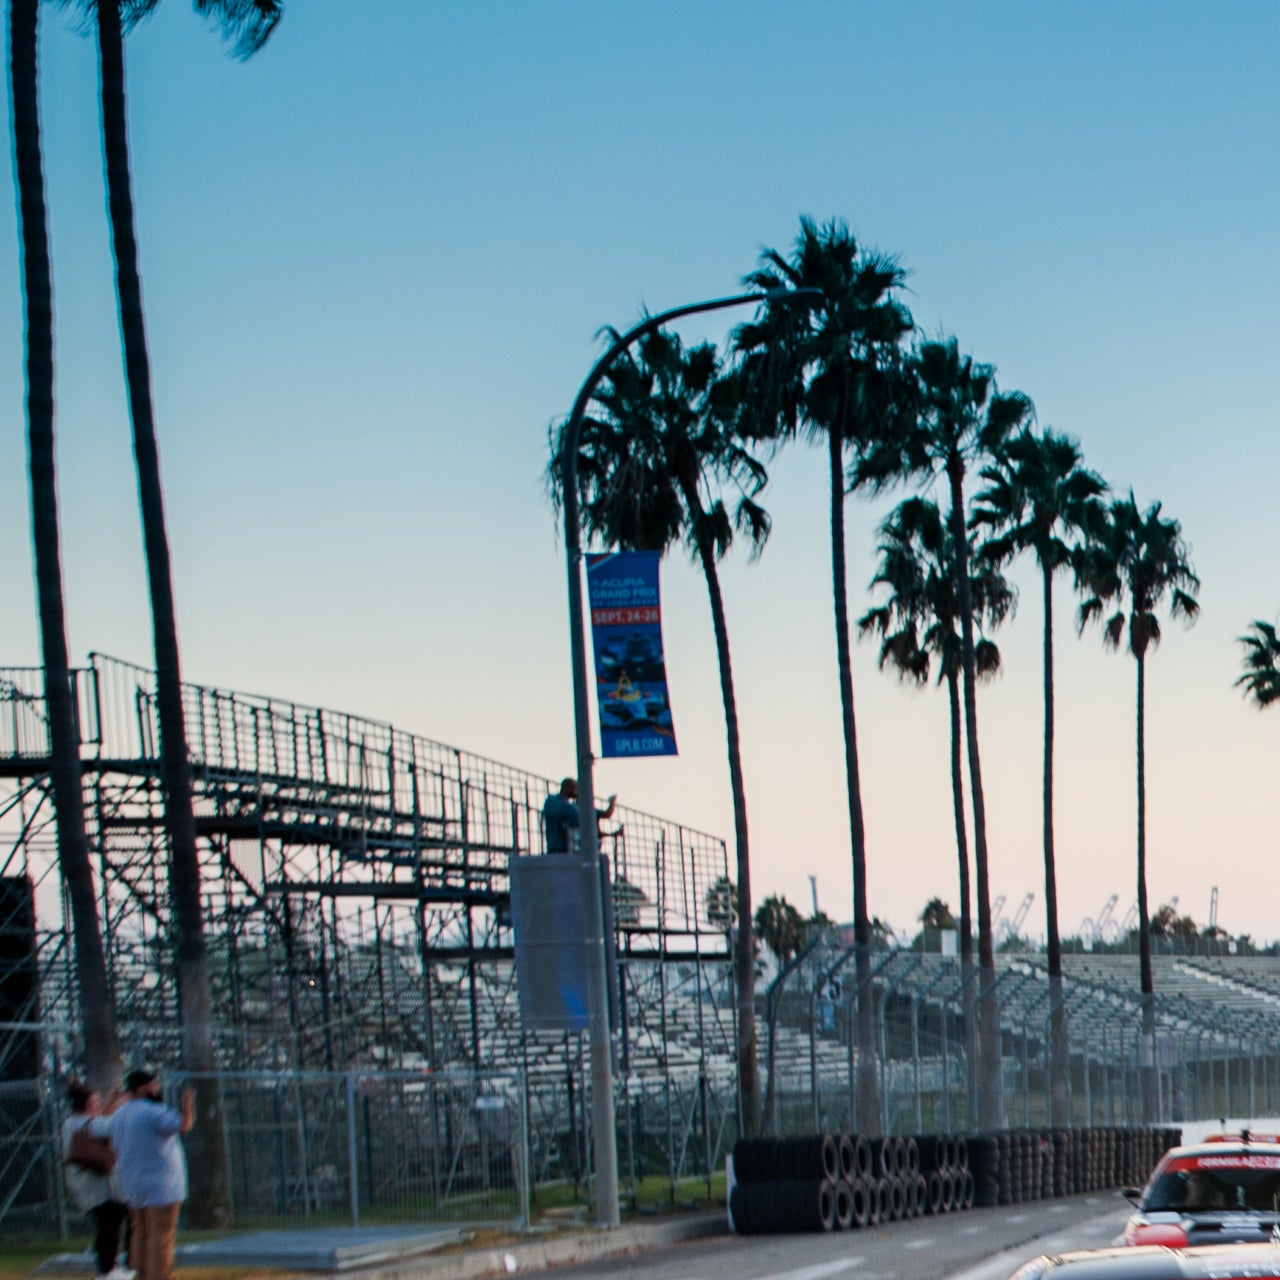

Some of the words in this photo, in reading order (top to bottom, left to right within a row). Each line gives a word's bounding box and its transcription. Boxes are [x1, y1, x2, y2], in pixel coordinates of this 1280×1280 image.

[592, 588, 630, 599] GRAND
[633, 587, 657, 597] PRIX
[594, 611, 623, 622] SEPT.
[627, 609, 659, 621] 24-26
